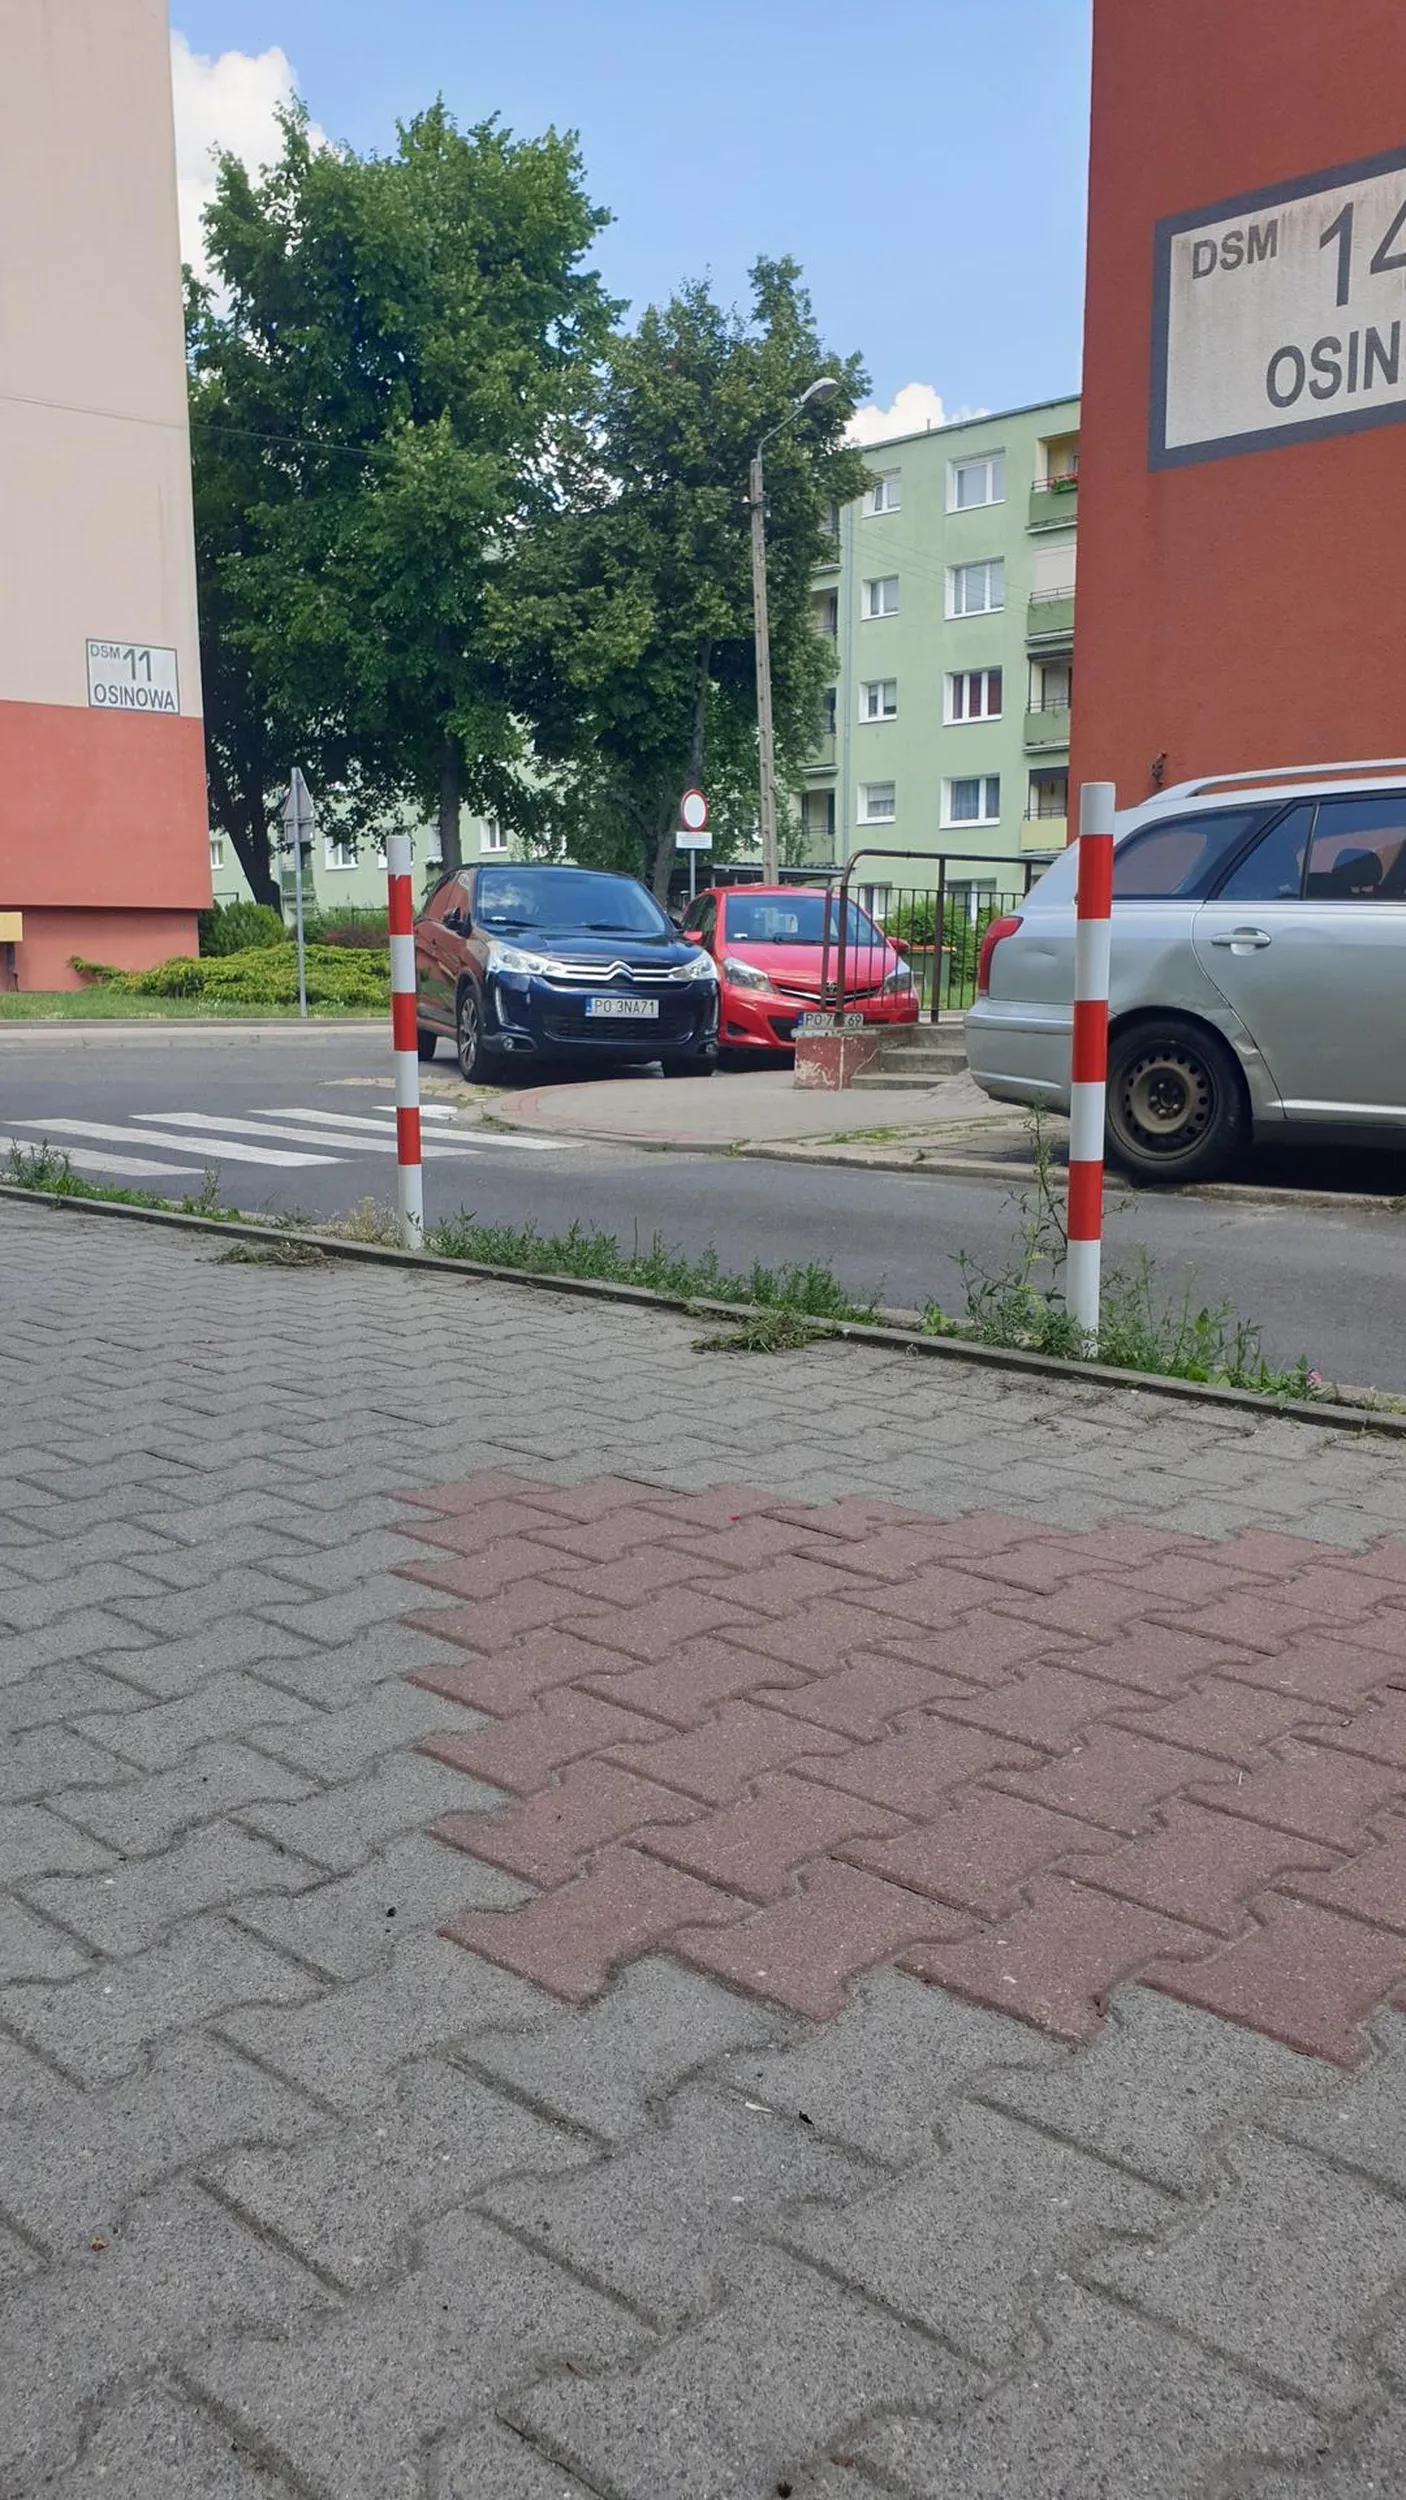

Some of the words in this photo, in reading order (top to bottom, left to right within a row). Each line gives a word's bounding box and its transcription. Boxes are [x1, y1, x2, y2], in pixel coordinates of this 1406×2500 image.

[1192, 218, 1278, 280] DSM
[1266, 321, 1401, 408] OSIN
[90, 644, 121, 659] DSM
[123, 648, 152, 682] 11
[94, 683, 176, 710] OSINOWA
[594, 999, 612, 1013] PO
[617, 1000, 654, 1014] 3NA71
[826, 1014, 862, 1028] 769
